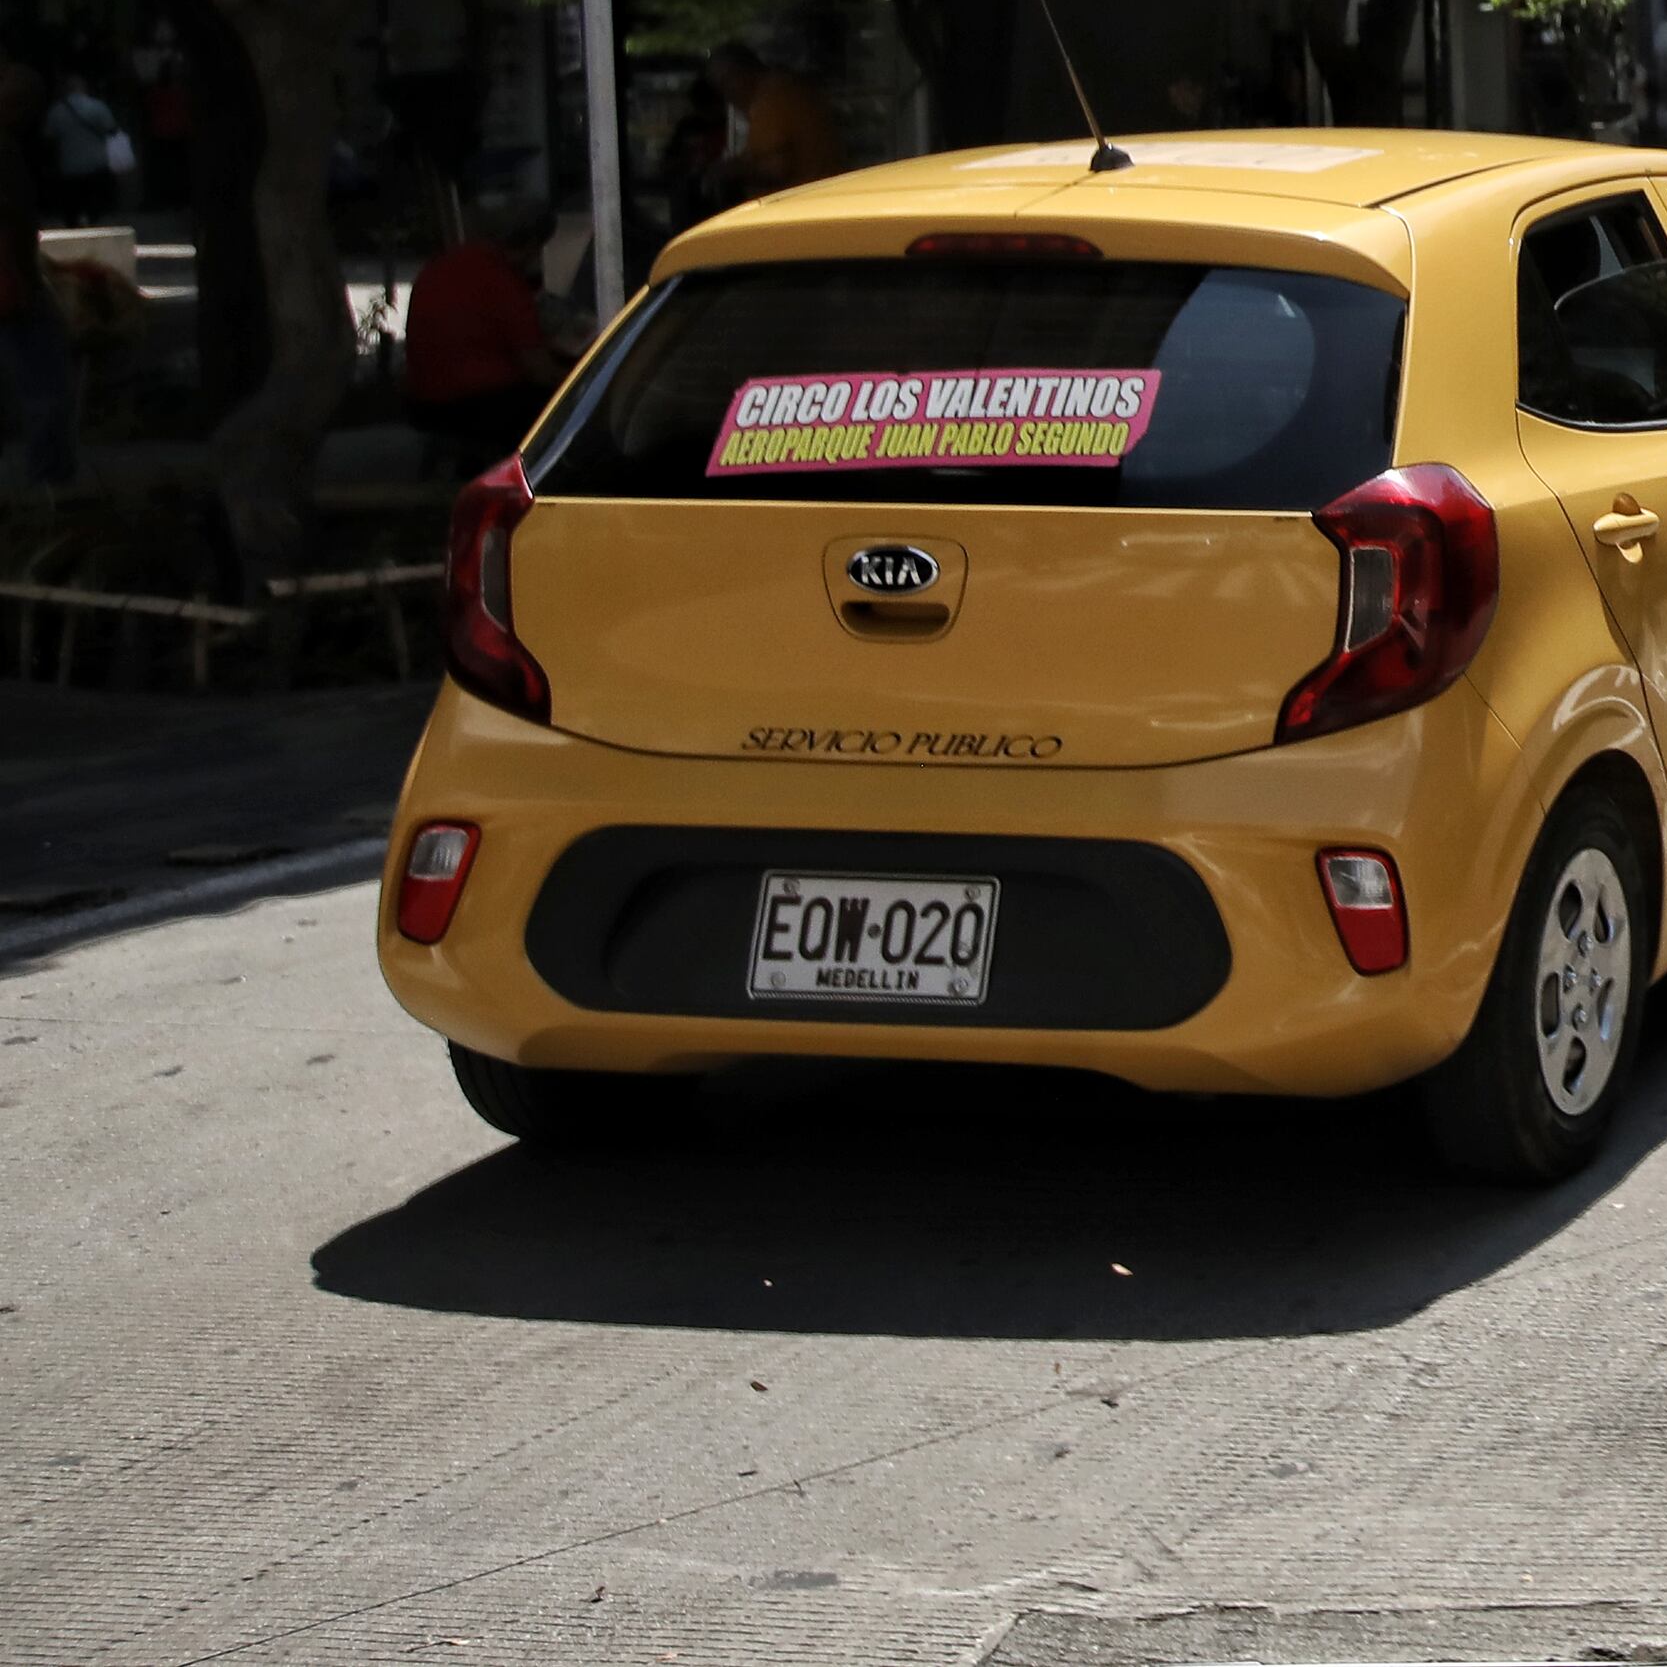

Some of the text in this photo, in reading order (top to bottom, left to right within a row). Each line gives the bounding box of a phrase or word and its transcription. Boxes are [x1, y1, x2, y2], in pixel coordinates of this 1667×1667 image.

[737, 376, 1146, 428] CIRCO LOS VALENTINOS
[719, 422, 1131, 467] AEROPARQUE JUAN PABLO SEGUNDO
[861, 555, 922, 586] KIA
[741, 727, 1064, 759] SERVICIO PUBLICO
[815, 967, 920, 991] MEDELLIN
